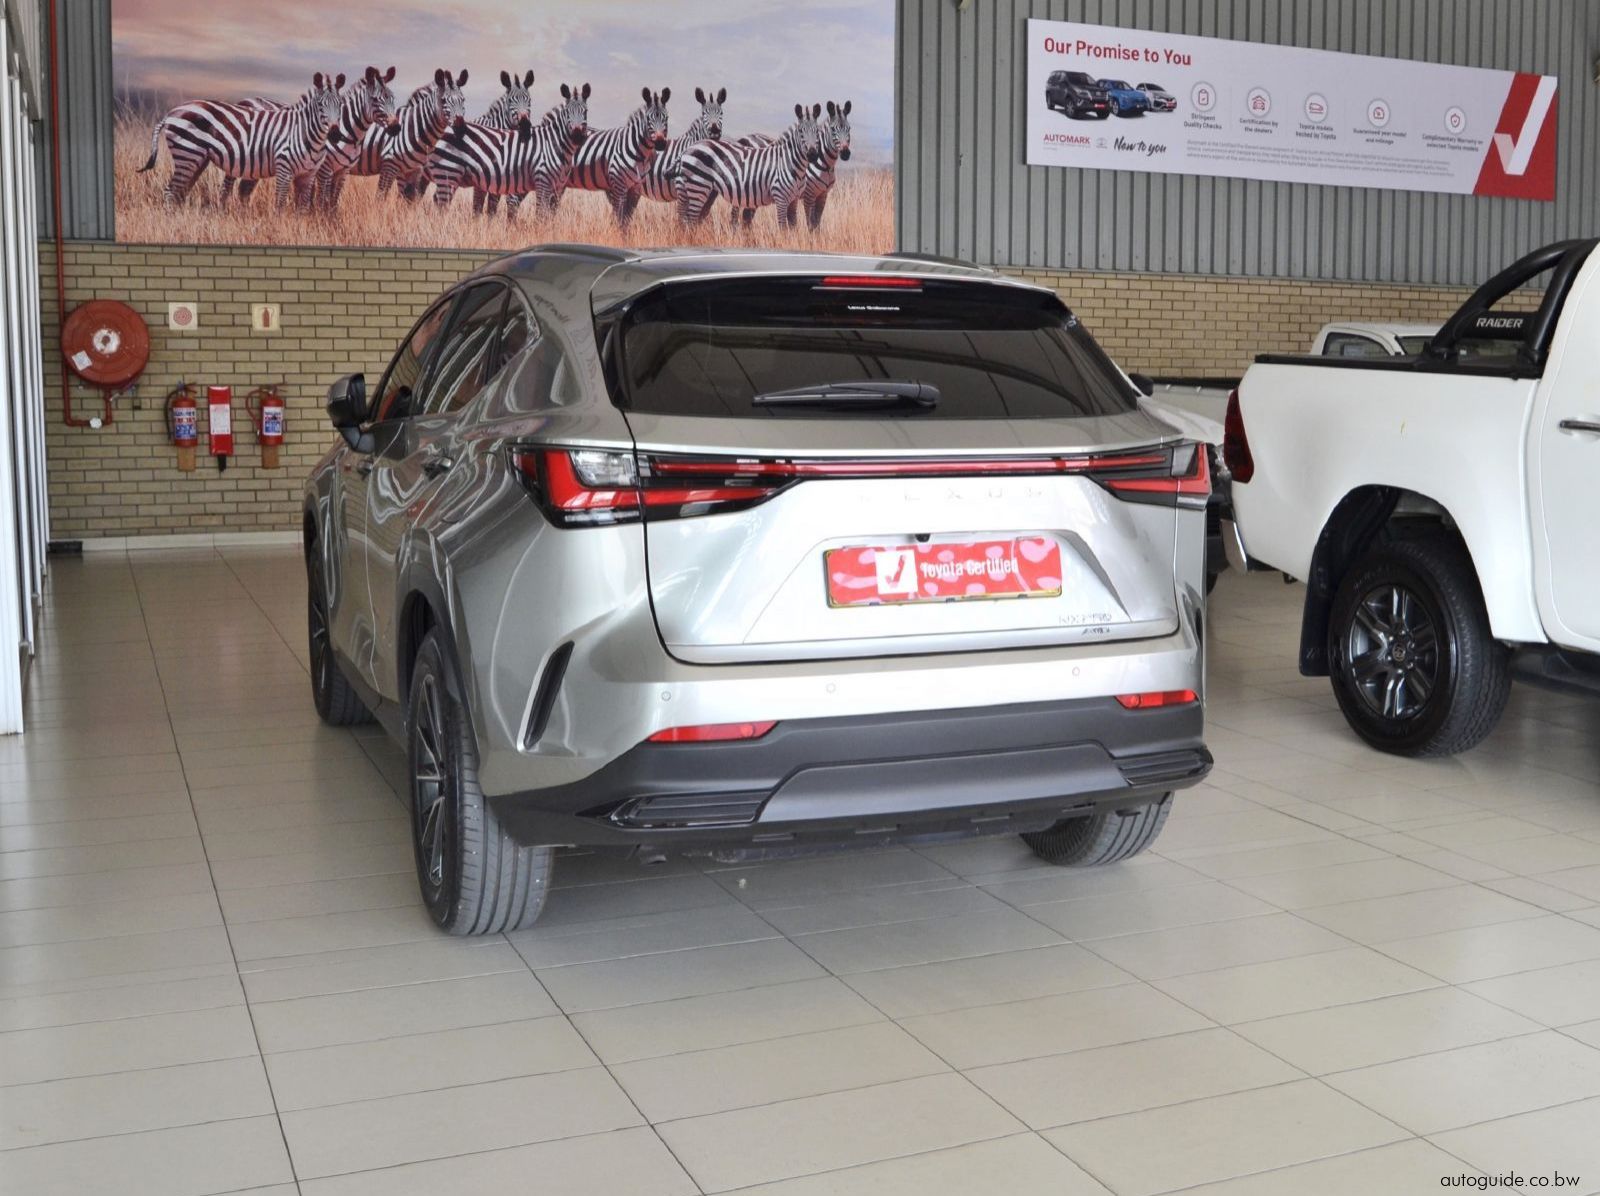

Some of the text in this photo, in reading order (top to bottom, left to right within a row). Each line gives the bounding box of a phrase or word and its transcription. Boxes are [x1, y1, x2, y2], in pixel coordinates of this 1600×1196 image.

[1044, 37, 1192, 66] Our Promise to You
[1183, 120, 1223, 130] Quality Checks
[1043, 133, 1091, 145] AUTOMARK
[1113, 135, 1168, 157] New to you
[1475, 317, 1524, 328] RAIDER
[920, 557, 1019, 579] Toyota Certified
